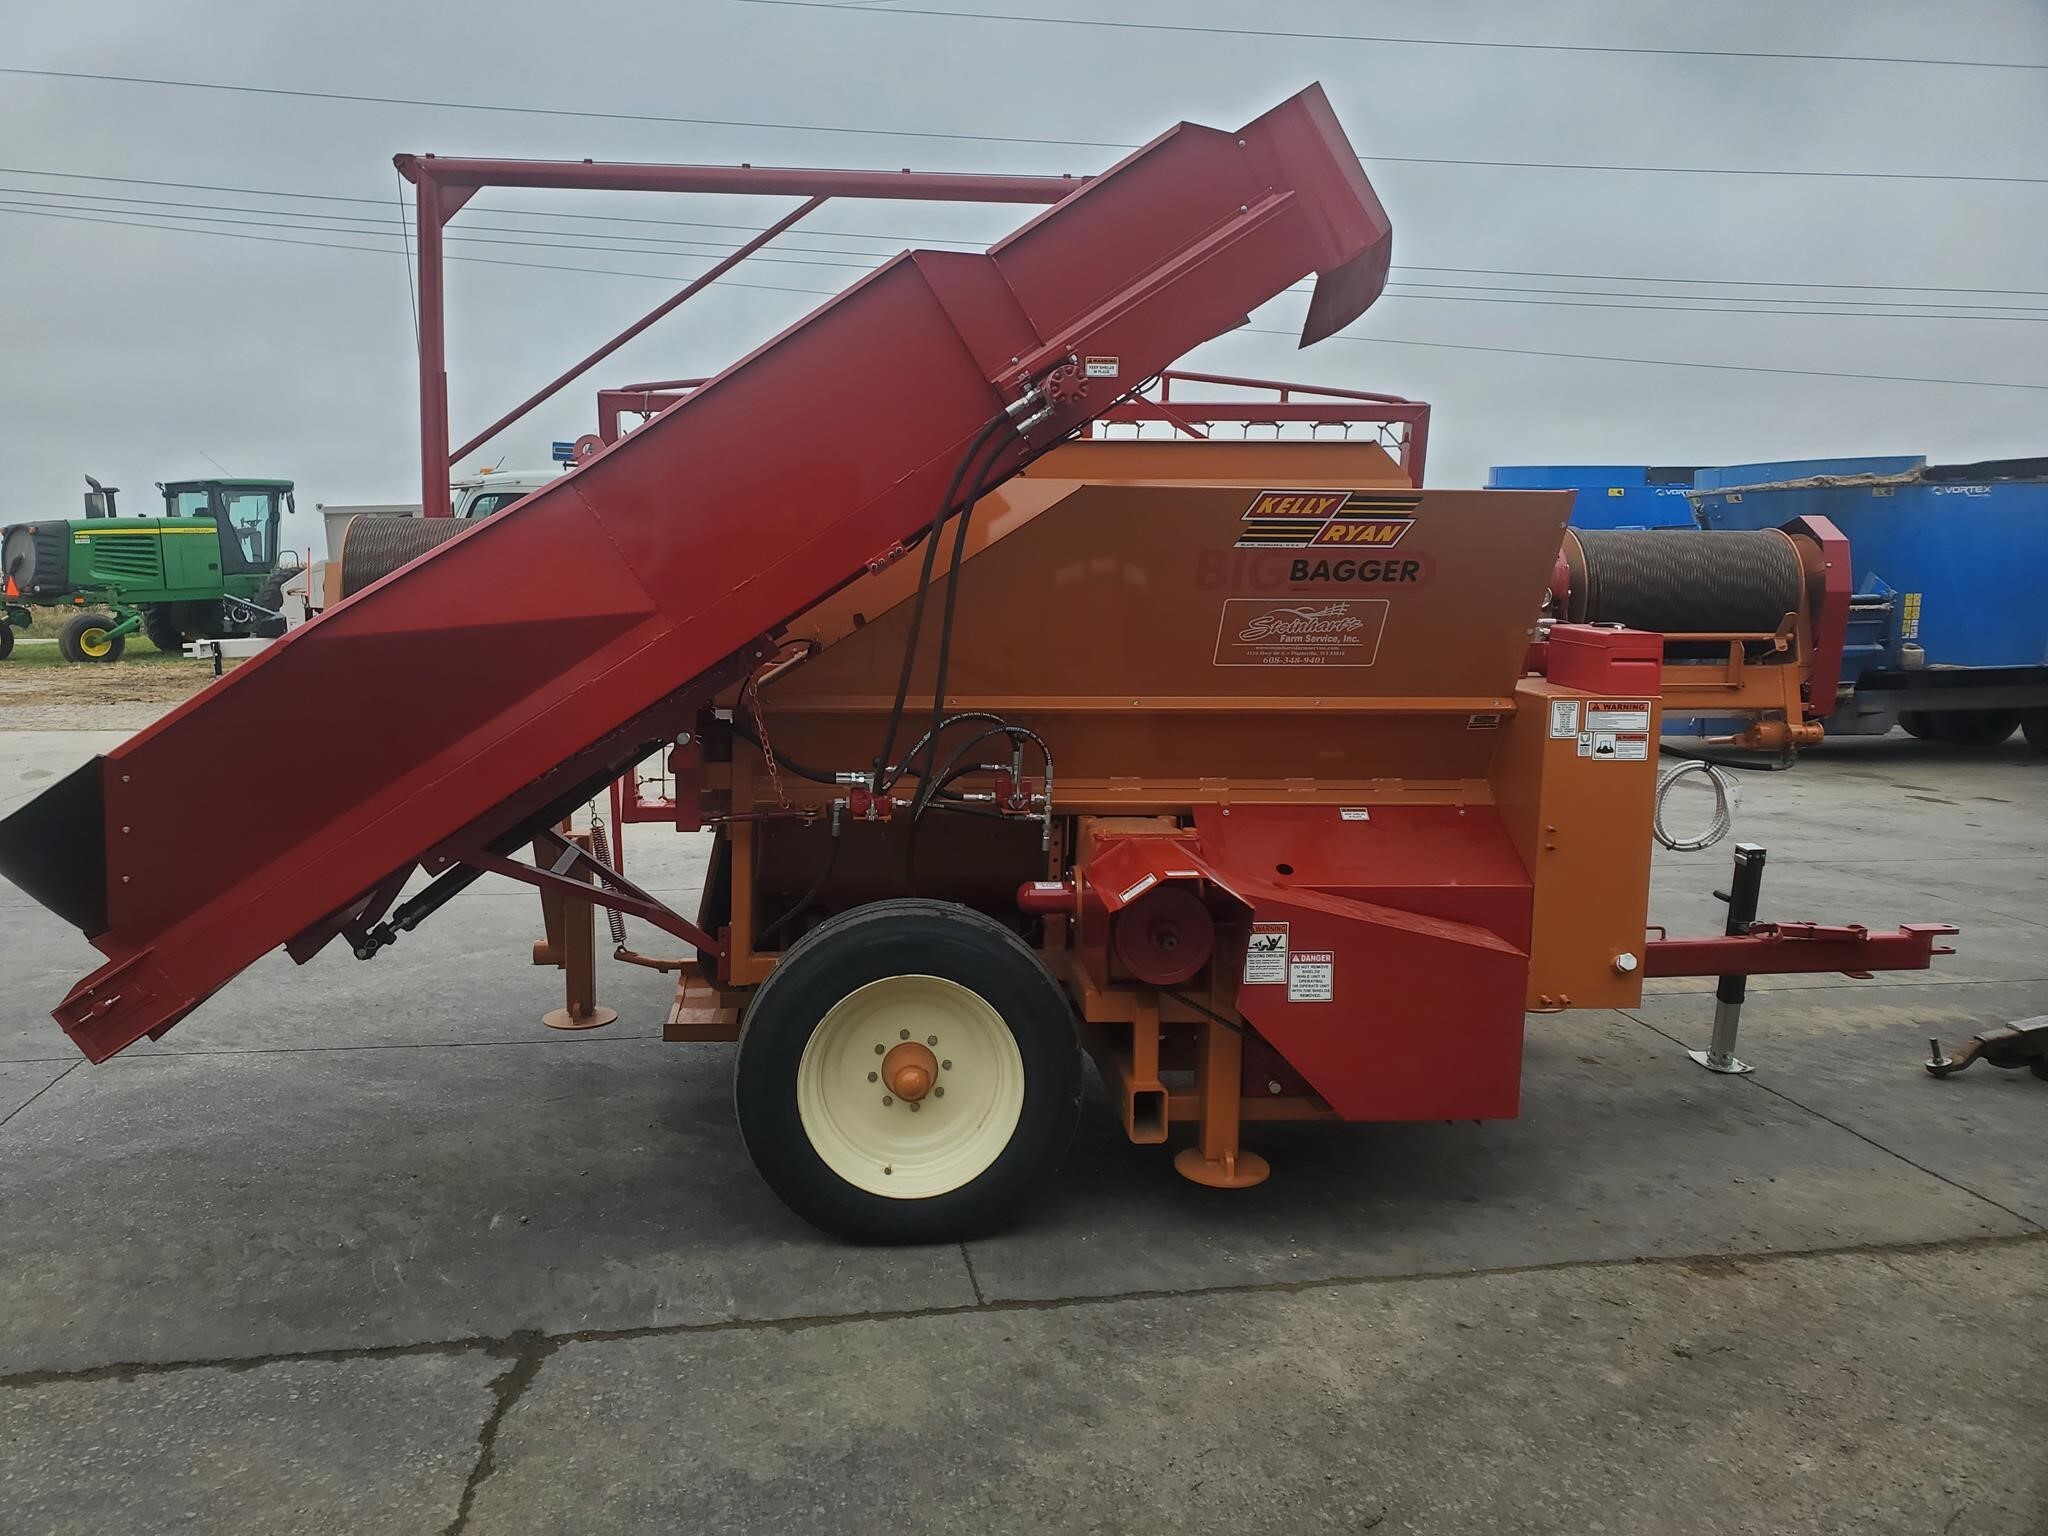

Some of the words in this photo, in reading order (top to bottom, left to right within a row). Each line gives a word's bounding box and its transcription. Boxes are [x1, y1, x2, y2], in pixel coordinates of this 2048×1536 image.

[1944, 486, 1991, 496] VORTEX
[1256, 497, 1337, 514] KELLY
[1322, 525, 1401, 542] RYAN
[1290, 559, 1421, 583] BAGGER
[1279, 634, 1303, 643] Farm
[1304, 634, 1340, 644] Service,
[1343, 634, 1360, 643] Inc.
[1263, 656, 1326, 664] 608-348-9401
[1301, 954, 1331, 962] DANGER
